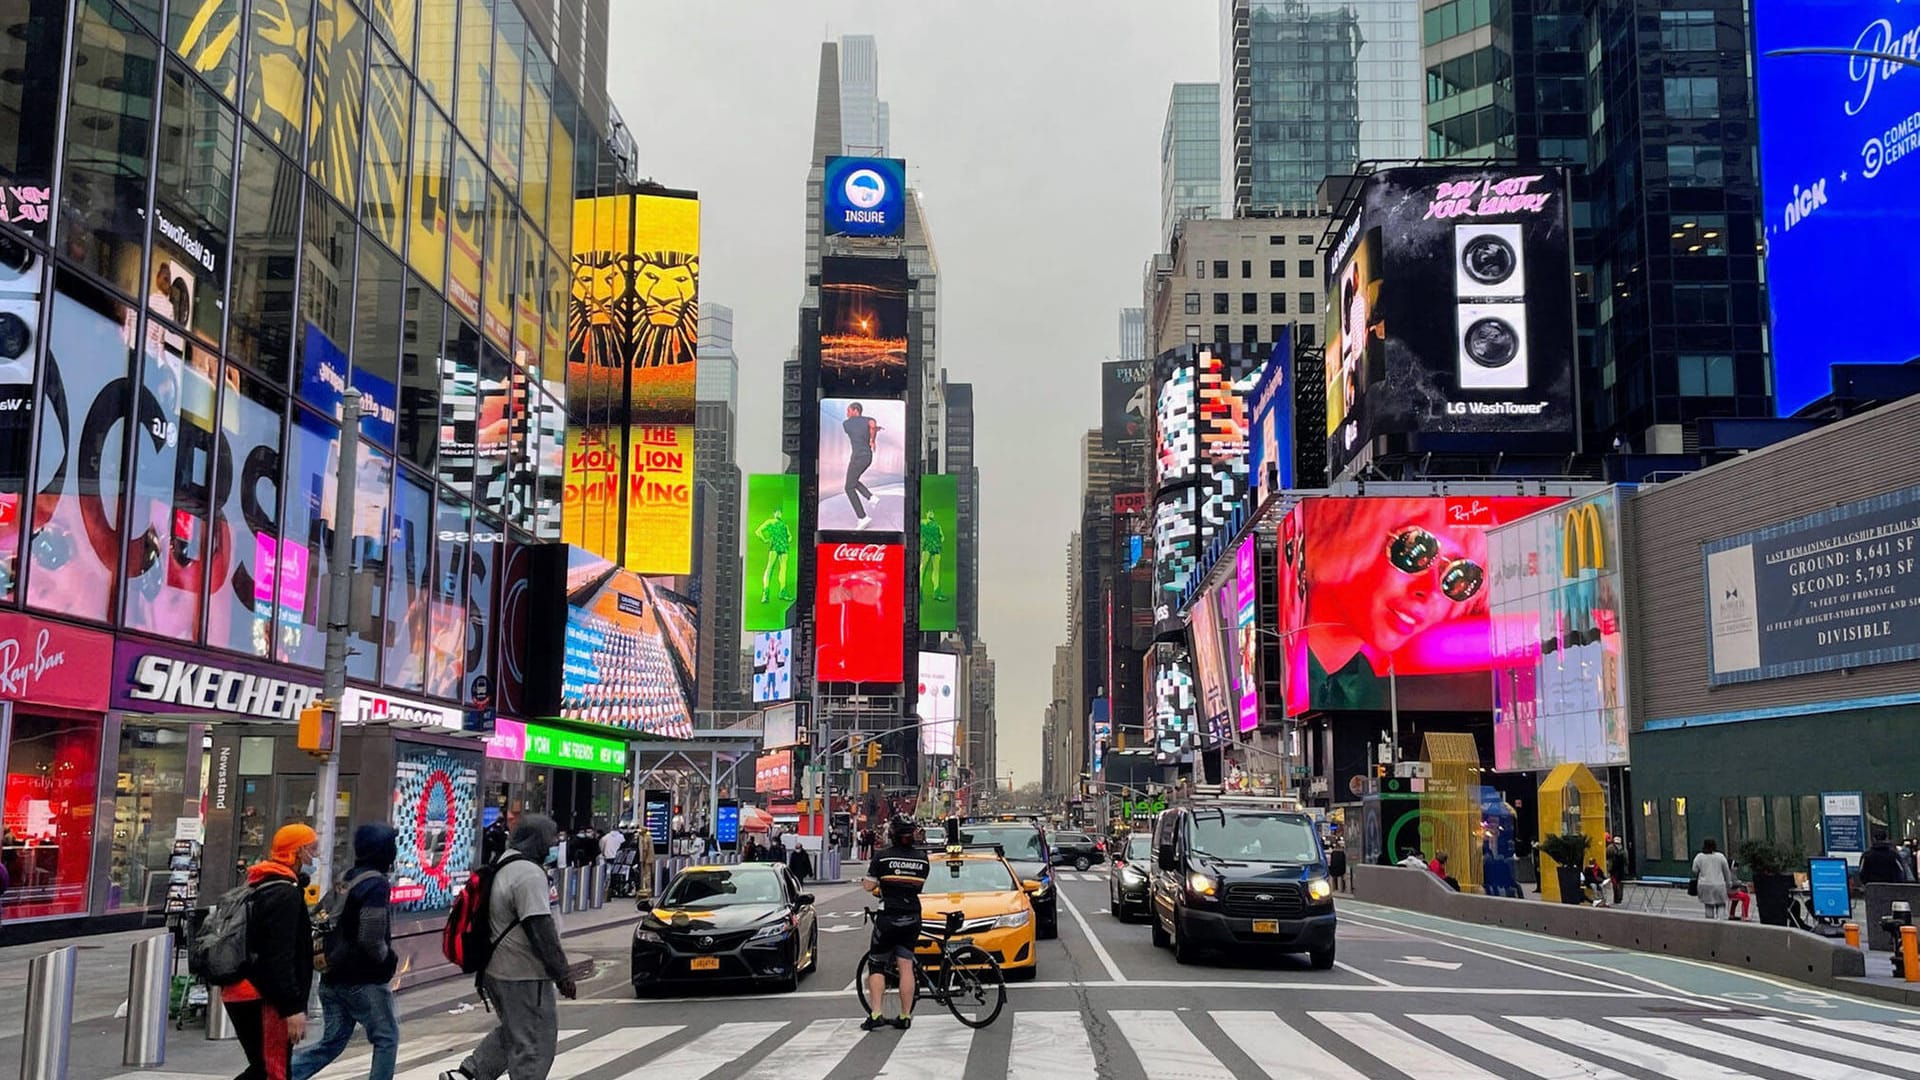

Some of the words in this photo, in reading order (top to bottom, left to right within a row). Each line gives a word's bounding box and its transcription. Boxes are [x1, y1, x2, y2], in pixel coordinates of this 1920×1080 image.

[845, 210, 885, 223] INSURE
[1447, 402, 1466, 414] LG
[1468, 401, 1543, 414] WashTower
[642, 427, 676, 442] THE
[635, 445, 683, 472] LION
[631, 474, 689, 508] KING
[1766, 552, 1784, 566] LAST
[1786, 537, 1831, 559] REMAINING
[1832, 527, 1875, 548] FLAGSHIP
[1876, 518, 1910, 538] RETAIL
[1789, 551, 1850, 576] GROUND:
[1855, 541, 1890, 562] 8,641
[1897, 535, 1914, 553] SF
[1791, 573, 1850, 596] SECOND:
[1856, 563, 1891, 584] 5,793
[1897, 558, 1914, 575] SF
[1820, 596, 1837, 607] FEET
[1840, 593, 1850, 602] OF
[1852, 585, 1896, 600] FRONTAGE
[1775, 619, 1792, 631] FEET
[1890, 599, 1907, 610] AND
[1818, 621, 1891, 646] DIVISIBLE
[216, 747, 231, 809] Newsstand
[888, 861, 923, 870] COLOMBIA
